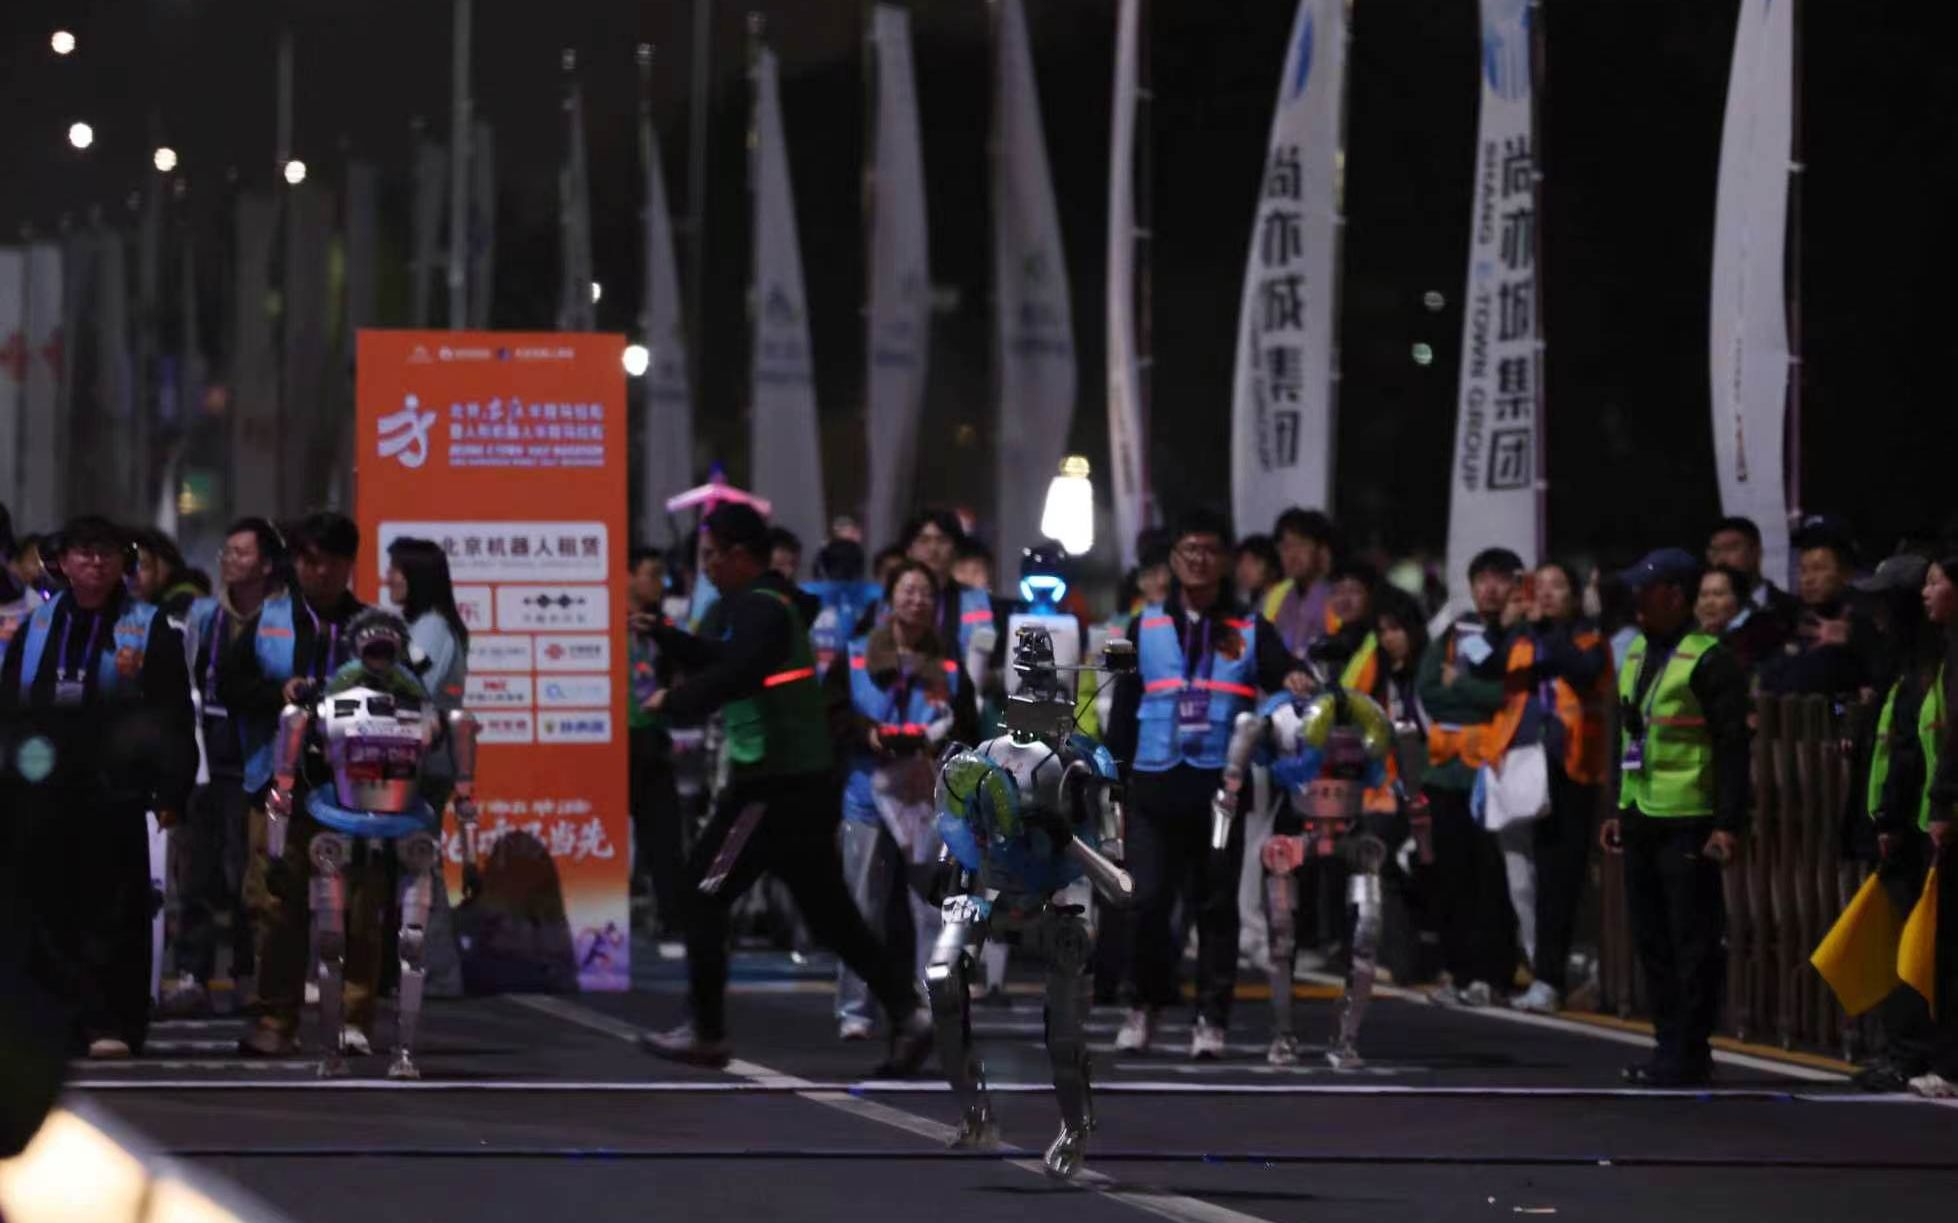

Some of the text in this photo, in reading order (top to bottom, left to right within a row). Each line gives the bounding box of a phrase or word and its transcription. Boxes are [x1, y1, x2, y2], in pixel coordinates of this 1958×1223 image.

[1487, 133, 1536, 491] 尚亦城集团
[443, 536, 599, 557] 北京机器人租赁
